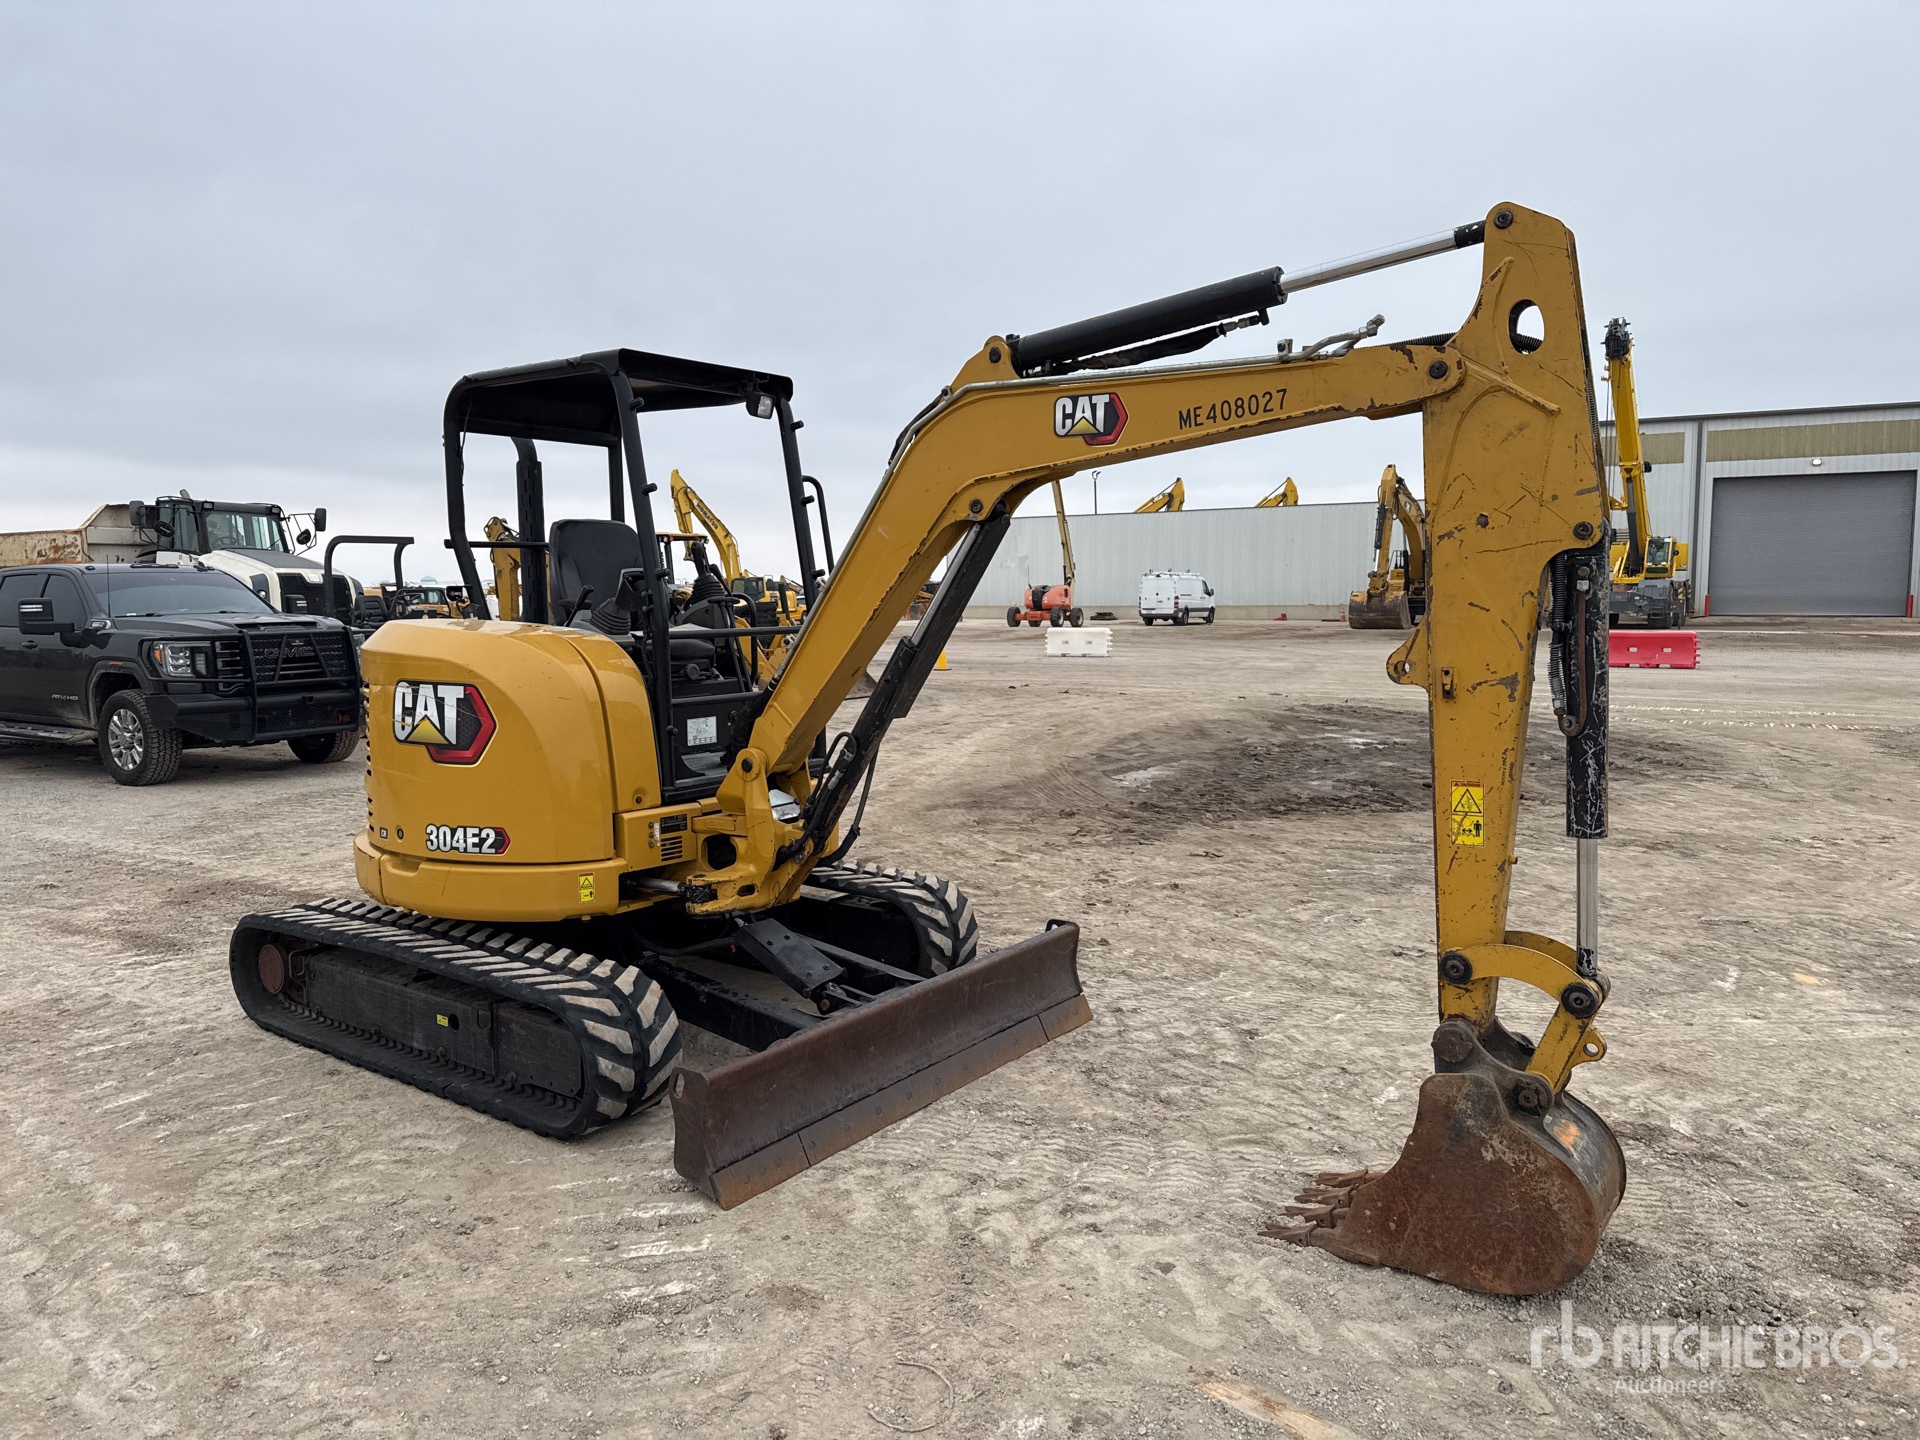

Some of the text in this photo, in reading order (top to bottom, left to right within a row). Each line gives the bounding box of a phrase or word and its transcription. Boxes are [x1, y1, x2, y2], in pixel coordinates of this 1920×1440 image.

[1055, 393, 1110, 436] CAT
[1178, 388, 1288, 430] ME408027
[393, 680, 465, 745] CAT
[426, 823, 496, 854] 304E2
